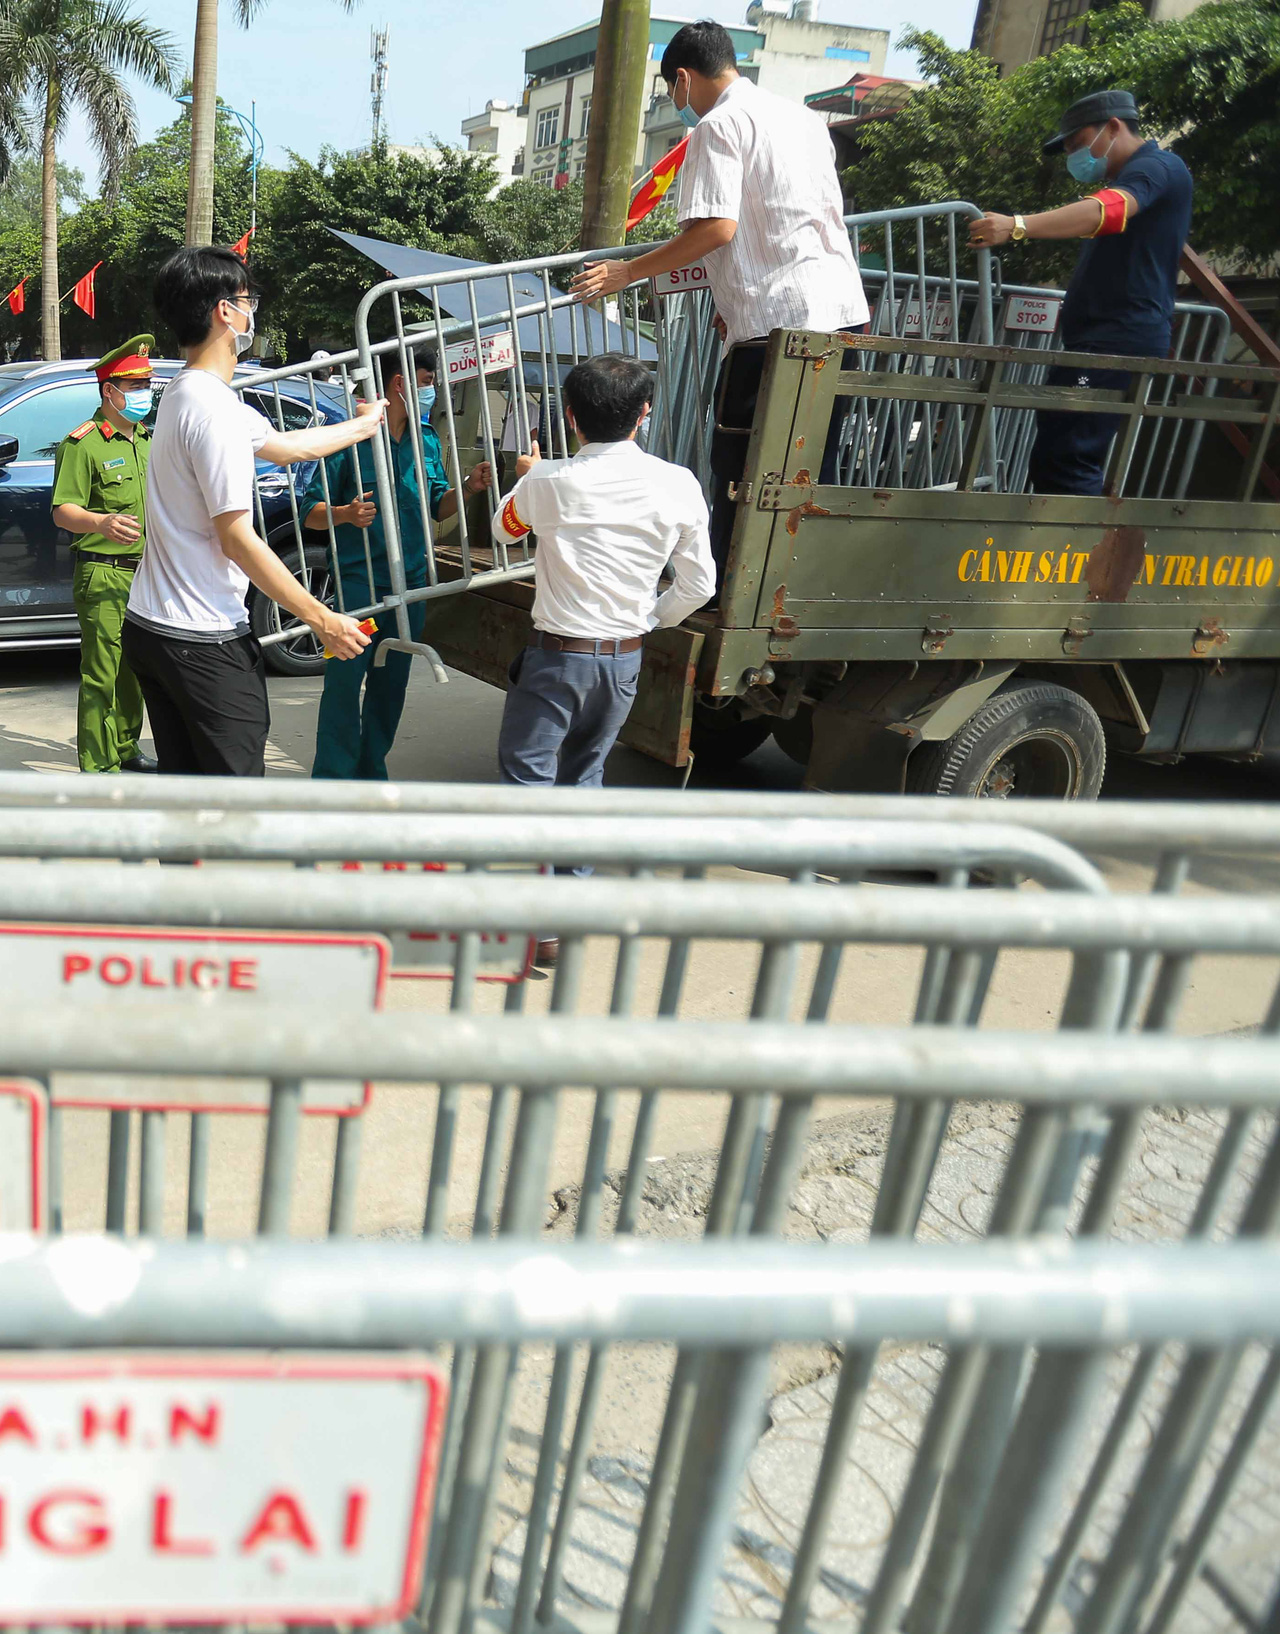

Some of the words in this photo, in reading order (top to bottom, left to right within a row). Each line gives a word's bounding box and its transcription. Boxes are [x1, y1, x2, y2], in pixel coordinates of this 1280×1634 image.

[1023, 301, 1047, 309] POLICE
[1016, 312, 1047, 324] STOP
[489, 348, 510, 362] LẠI
[958, 537, 1035, 583] CẢNH
[1035, 544, 1090, 584] SÁT
[1161, 555, 1209, 587] TRA
[1213, 555, 1274, 587] GIAO
[61, 954, 260, 991] POLICE
[152, 1486, 367, 1575] LẠI
